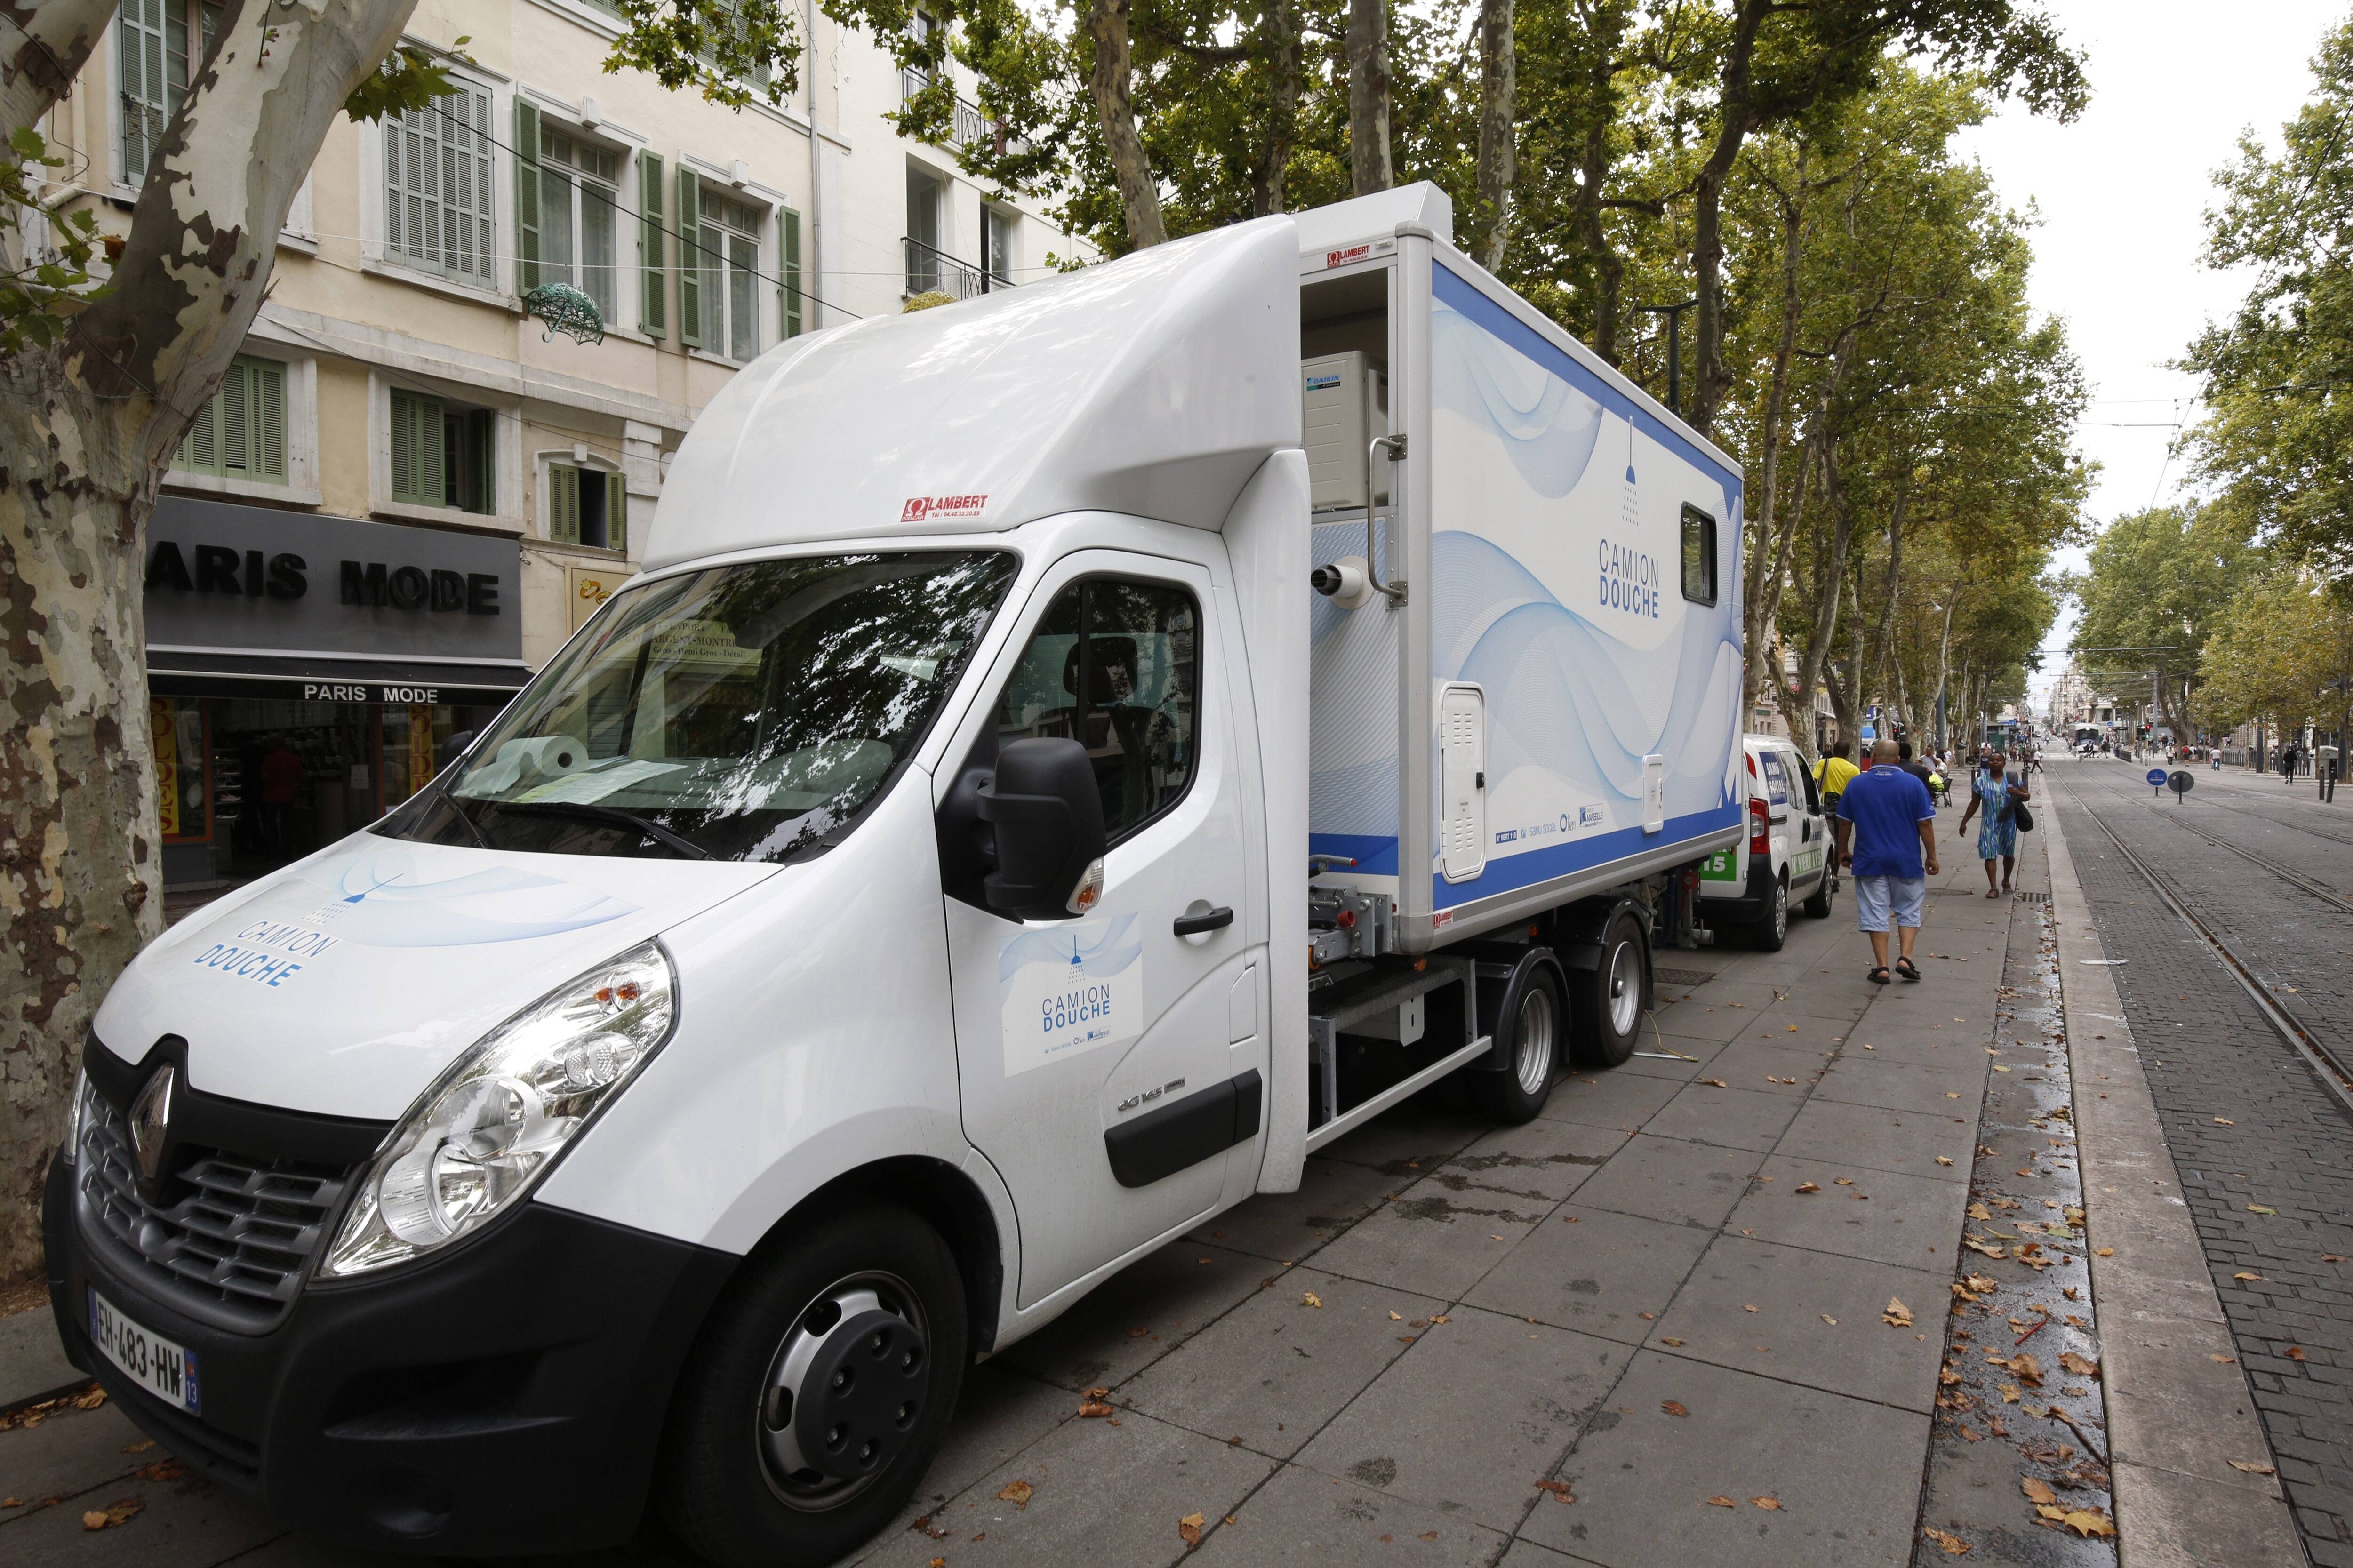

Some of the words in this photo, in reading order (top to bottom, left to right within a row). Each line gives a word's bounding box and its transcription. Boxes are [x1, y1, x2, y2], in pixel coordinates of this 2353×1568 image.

[1340, 245, 1369, 259] LAMBERT
[1314, 375, 1339, 384] DAIKIN
[928, 495, 988, 511] LAMBERT
[1599, 539, 1658, 589] CAMION
[144, 541, 308, 600] ARIS
[340, 560, 500, 615] MODE
[1600, 575, 1658, 618] DOUCHE
[724, 650, 745, 658] Détail
[304, 685, 366, 701] PARIS
[384, 687, 438, 703] MODE
[1766, 762, 1780, 776] SAMU
[1769, 780, 1785, 794] SOCIAL
[1501, 833, 1509, 841] VERT
[1704, 856, 1726, 872] 15
[1798, 852, 1811, 872] VERT
[1812, 849, 1822, 868] 115
[237, 920, 339, 958] CAMION
[194, 944, 302, 987] DOUCHE
[1042, 984, 1110, 1016] CAMION
[1043, 1000, 1110, 1032] DOUCHE
[98, 1301, 181, 1398] EH-483-HW
[187, 1380, 197, 1403] 13
